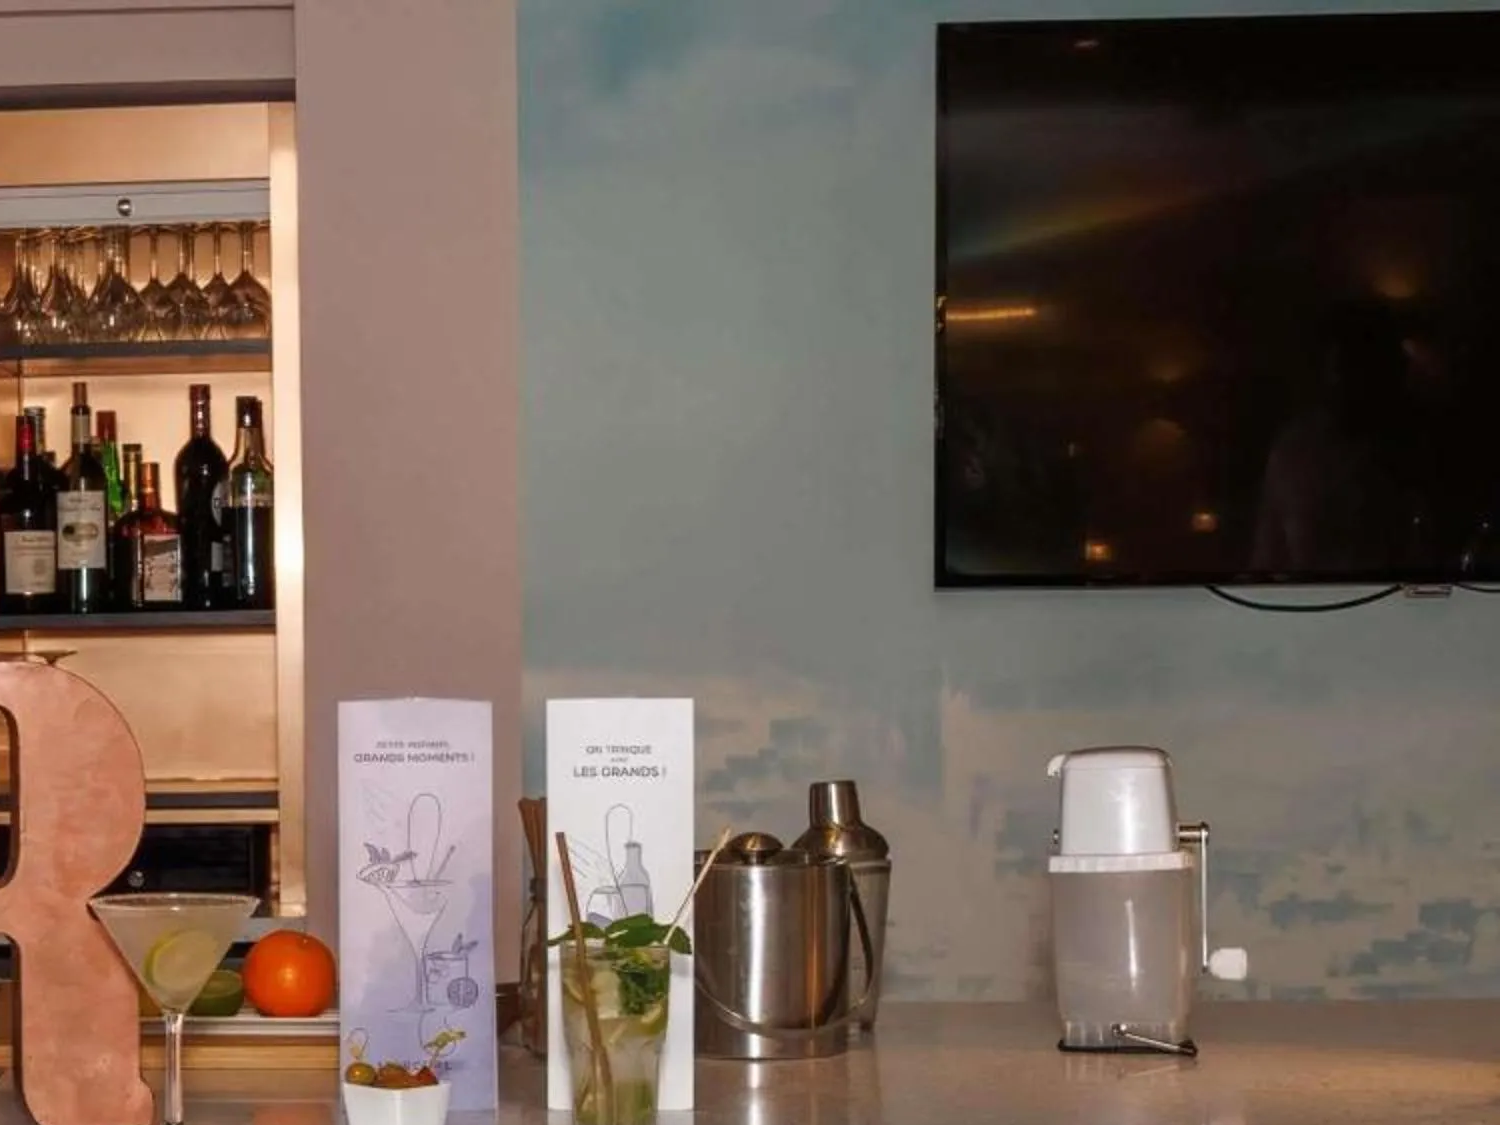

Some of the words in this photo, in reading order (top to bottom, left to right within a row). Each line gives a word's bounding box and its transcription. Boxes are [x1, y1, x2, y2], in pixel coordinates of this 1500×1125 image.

[407, 752, 469, 763] MOMENTS
[573, 766, 598, 778] LES
[601, 765, 660, 778] GRANDS
